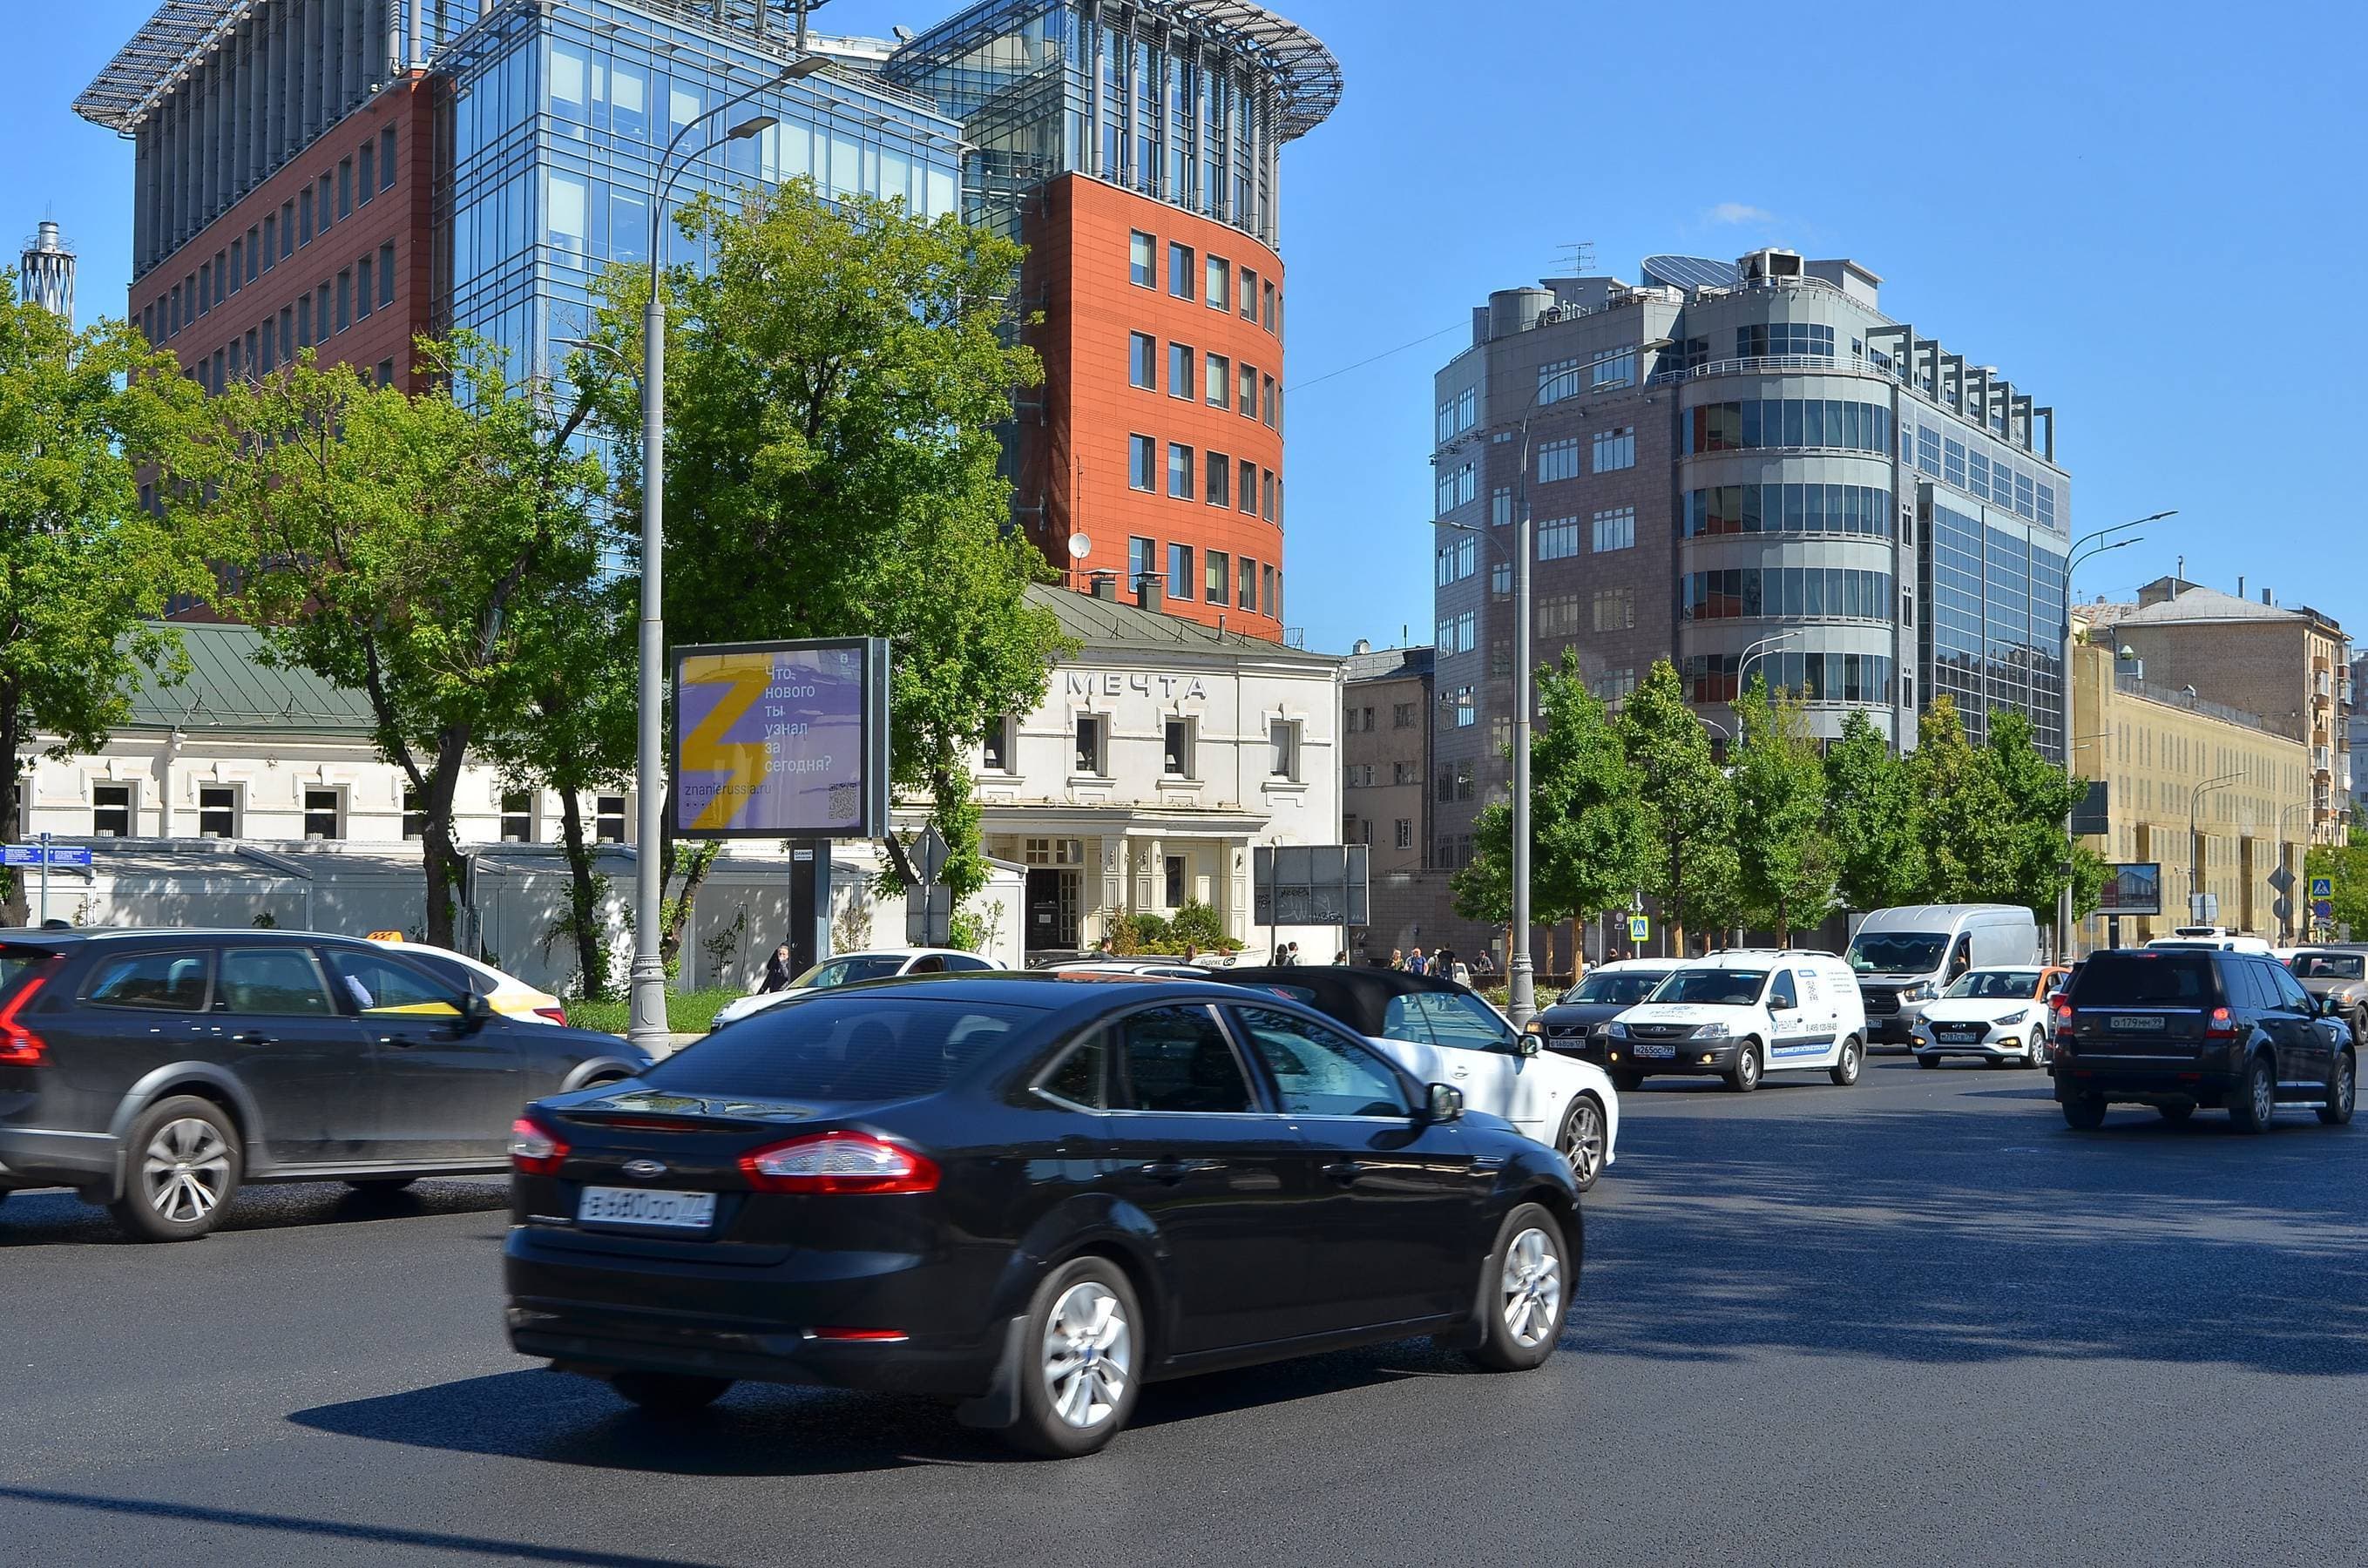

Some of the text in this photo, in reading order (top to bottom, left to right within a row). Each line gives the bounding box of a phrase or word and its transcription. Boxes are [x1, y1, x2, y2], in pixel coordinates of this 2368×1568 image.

[765, 665, 793, 681] Что
[765, 685, 815, 699] нового
[1067, 671, 1208, 700] МЕЧТА
[765, 705, 784, 718] ты
[765, 722, 809, 740] узнал
[765, 741, 781, 754] за
[765, 755, 832, 774] сегодня?
[685, 782, 772, 796] znanierussia.ru
